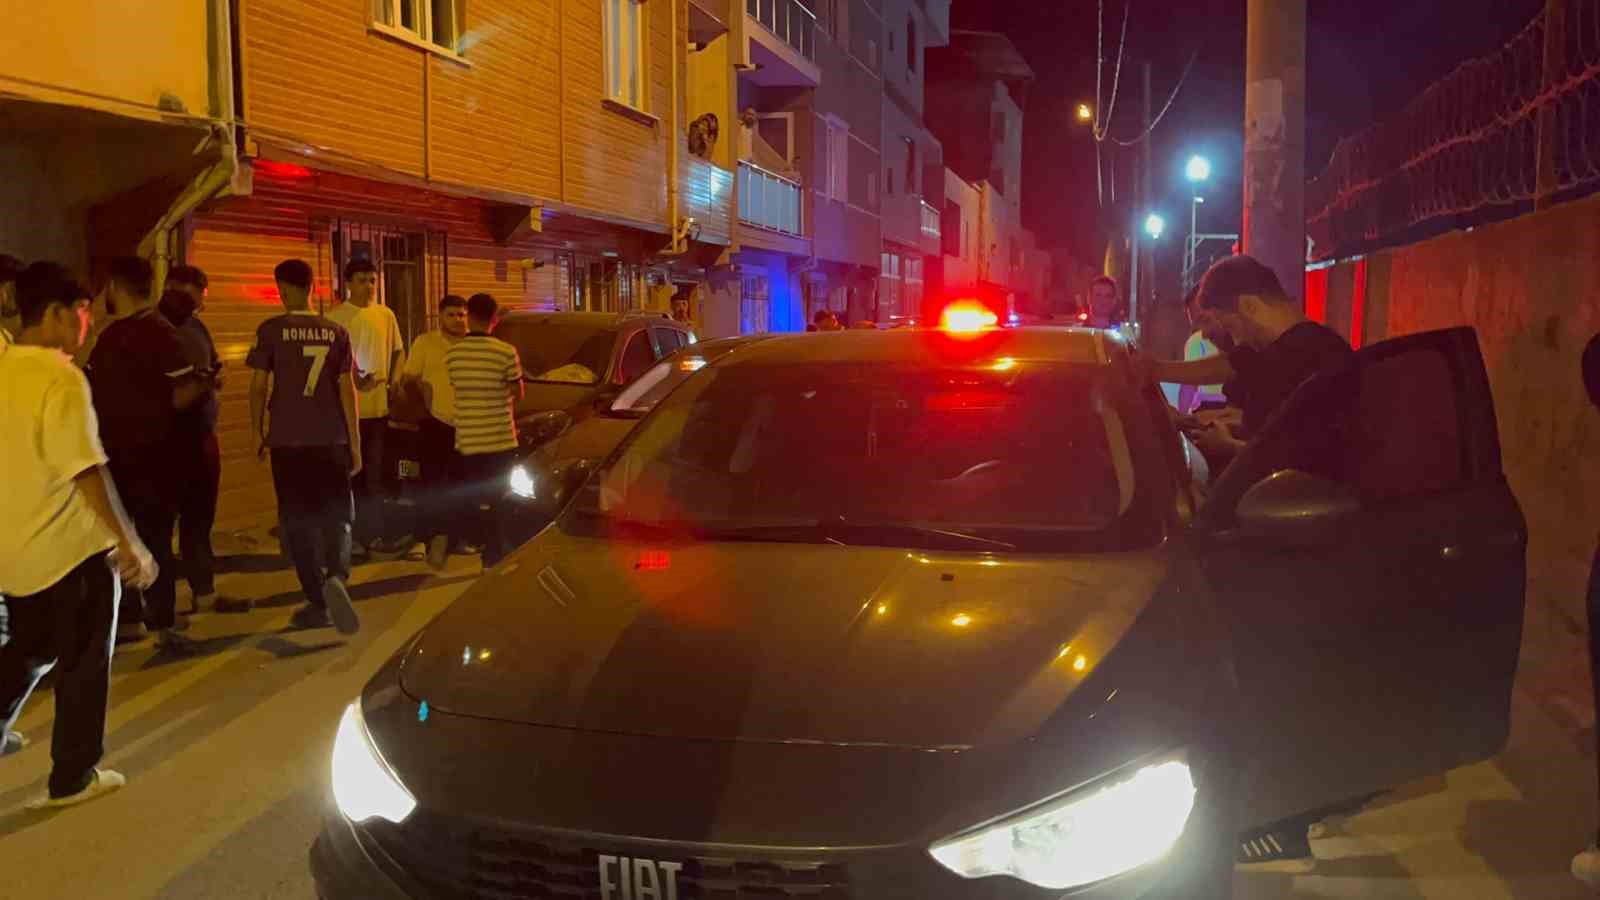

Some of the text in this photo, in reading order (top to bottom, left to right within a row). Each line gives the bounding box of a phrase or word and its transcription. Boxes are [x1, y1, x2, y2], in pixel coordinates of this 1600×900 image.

[282, 328, 335, 342] RONALDO
[303, 345, 330, 397] 7
[599, 854, 682, 900] FIAT
